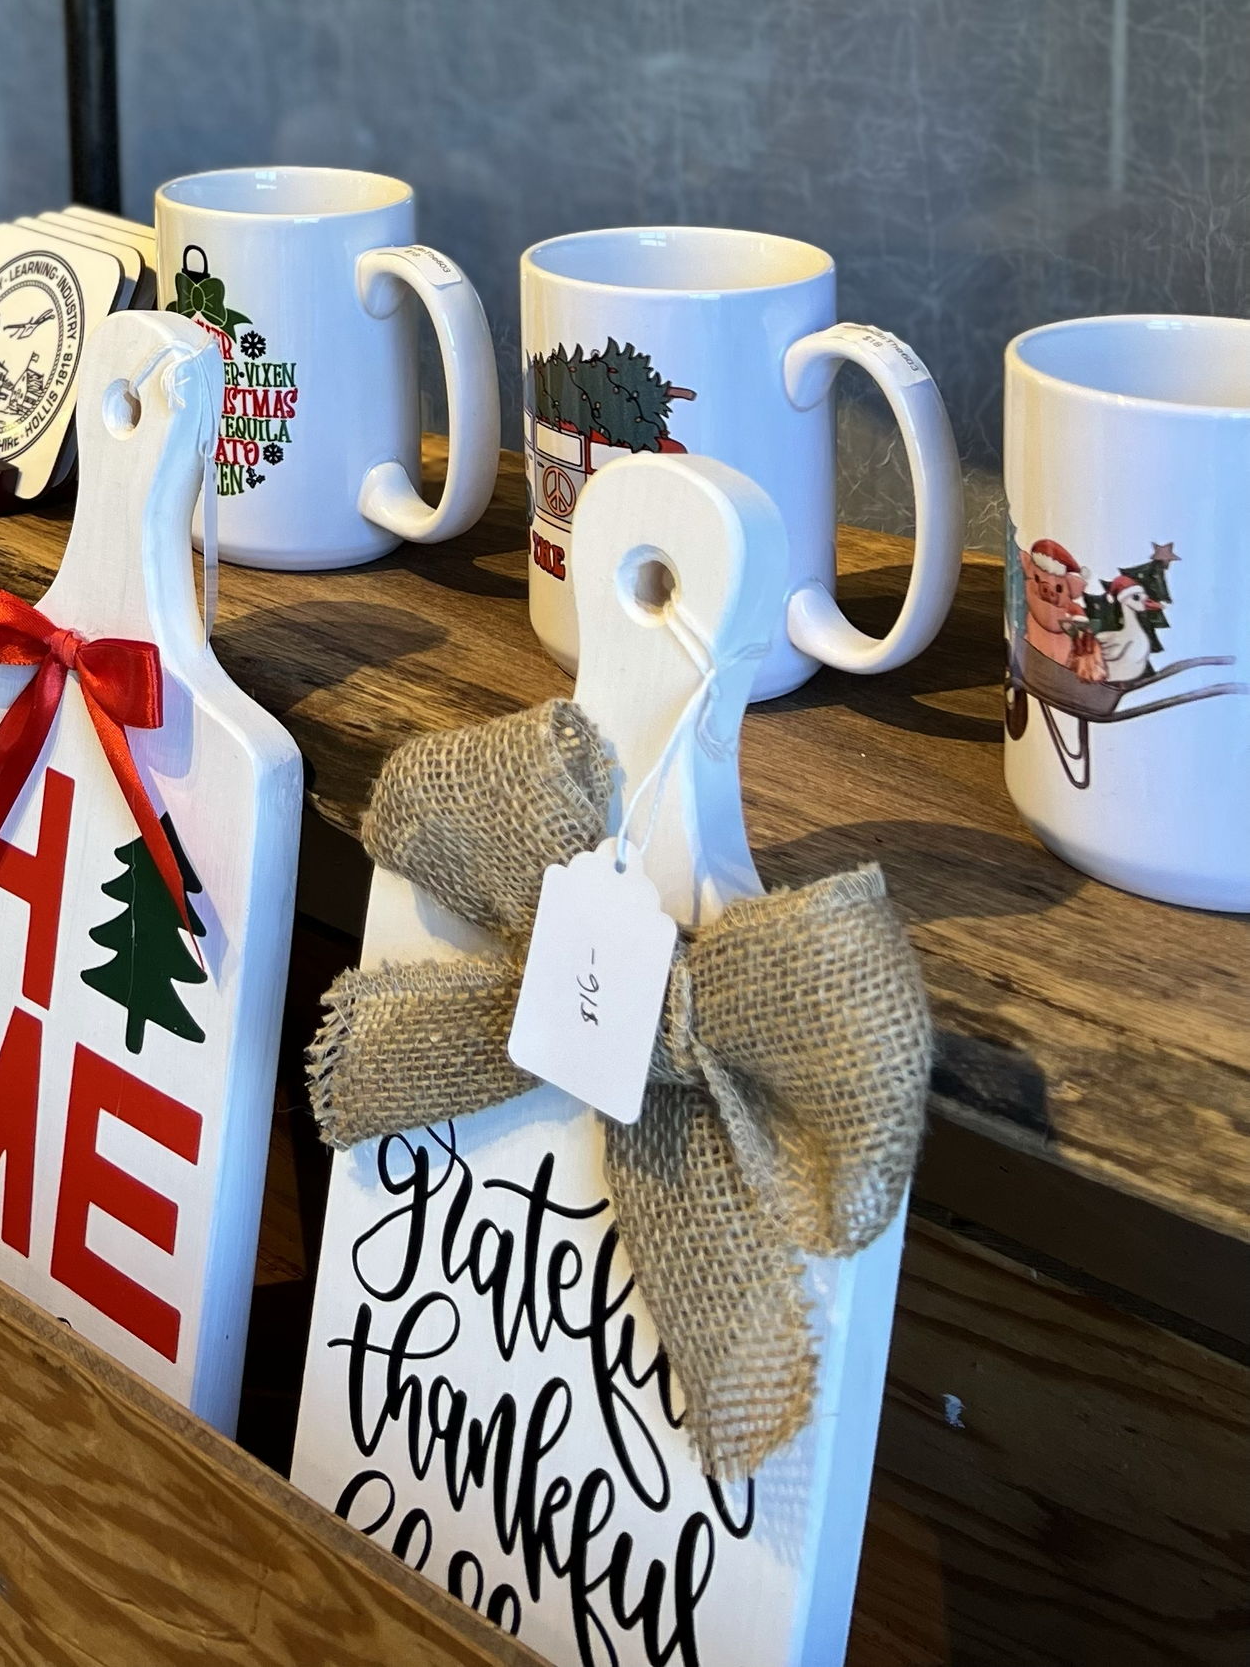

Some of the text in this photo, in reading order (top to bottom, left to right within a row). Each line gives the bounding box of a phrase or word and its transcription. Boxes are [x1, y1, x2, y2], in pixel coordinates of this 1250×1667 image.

[9, 260, 58, 283] LEARNING
[56, 275, 78, 340] INDUSTRY
[24, 390, 59, 438] HOLLIS
[55, 352, 73, 386] 1818
[532, 529, 566, 582] THE
[328, 1291, 716, 1667] thankful
